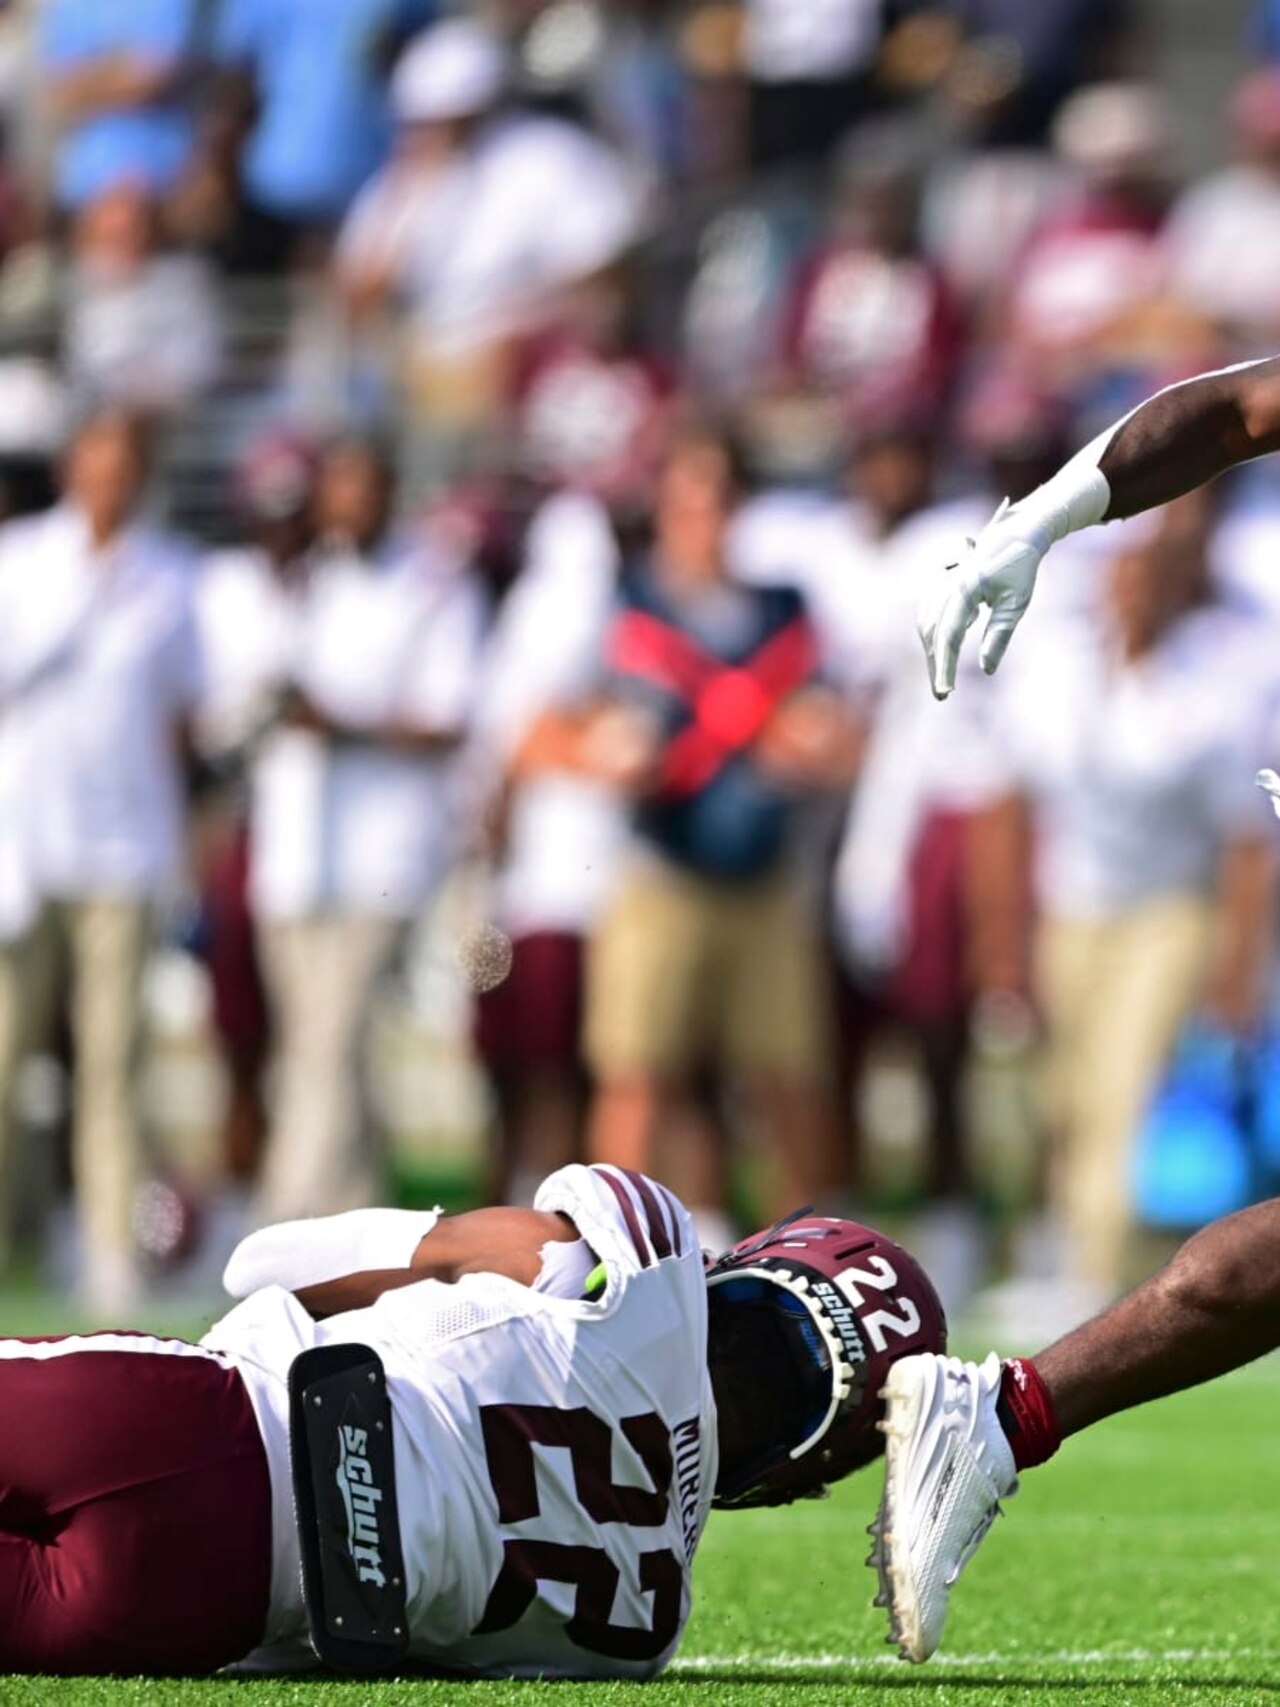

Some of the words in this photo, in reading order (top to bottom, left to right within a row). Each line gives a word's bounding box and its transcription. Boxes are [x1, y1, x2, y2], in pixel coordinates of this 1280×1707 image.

[810, 1282, 866, 1363] schutt
[833, 1255, 920, 1353] 22
[340, 1425, 386, 1588] schutt
[471, 1403, 682, 1661] 22
